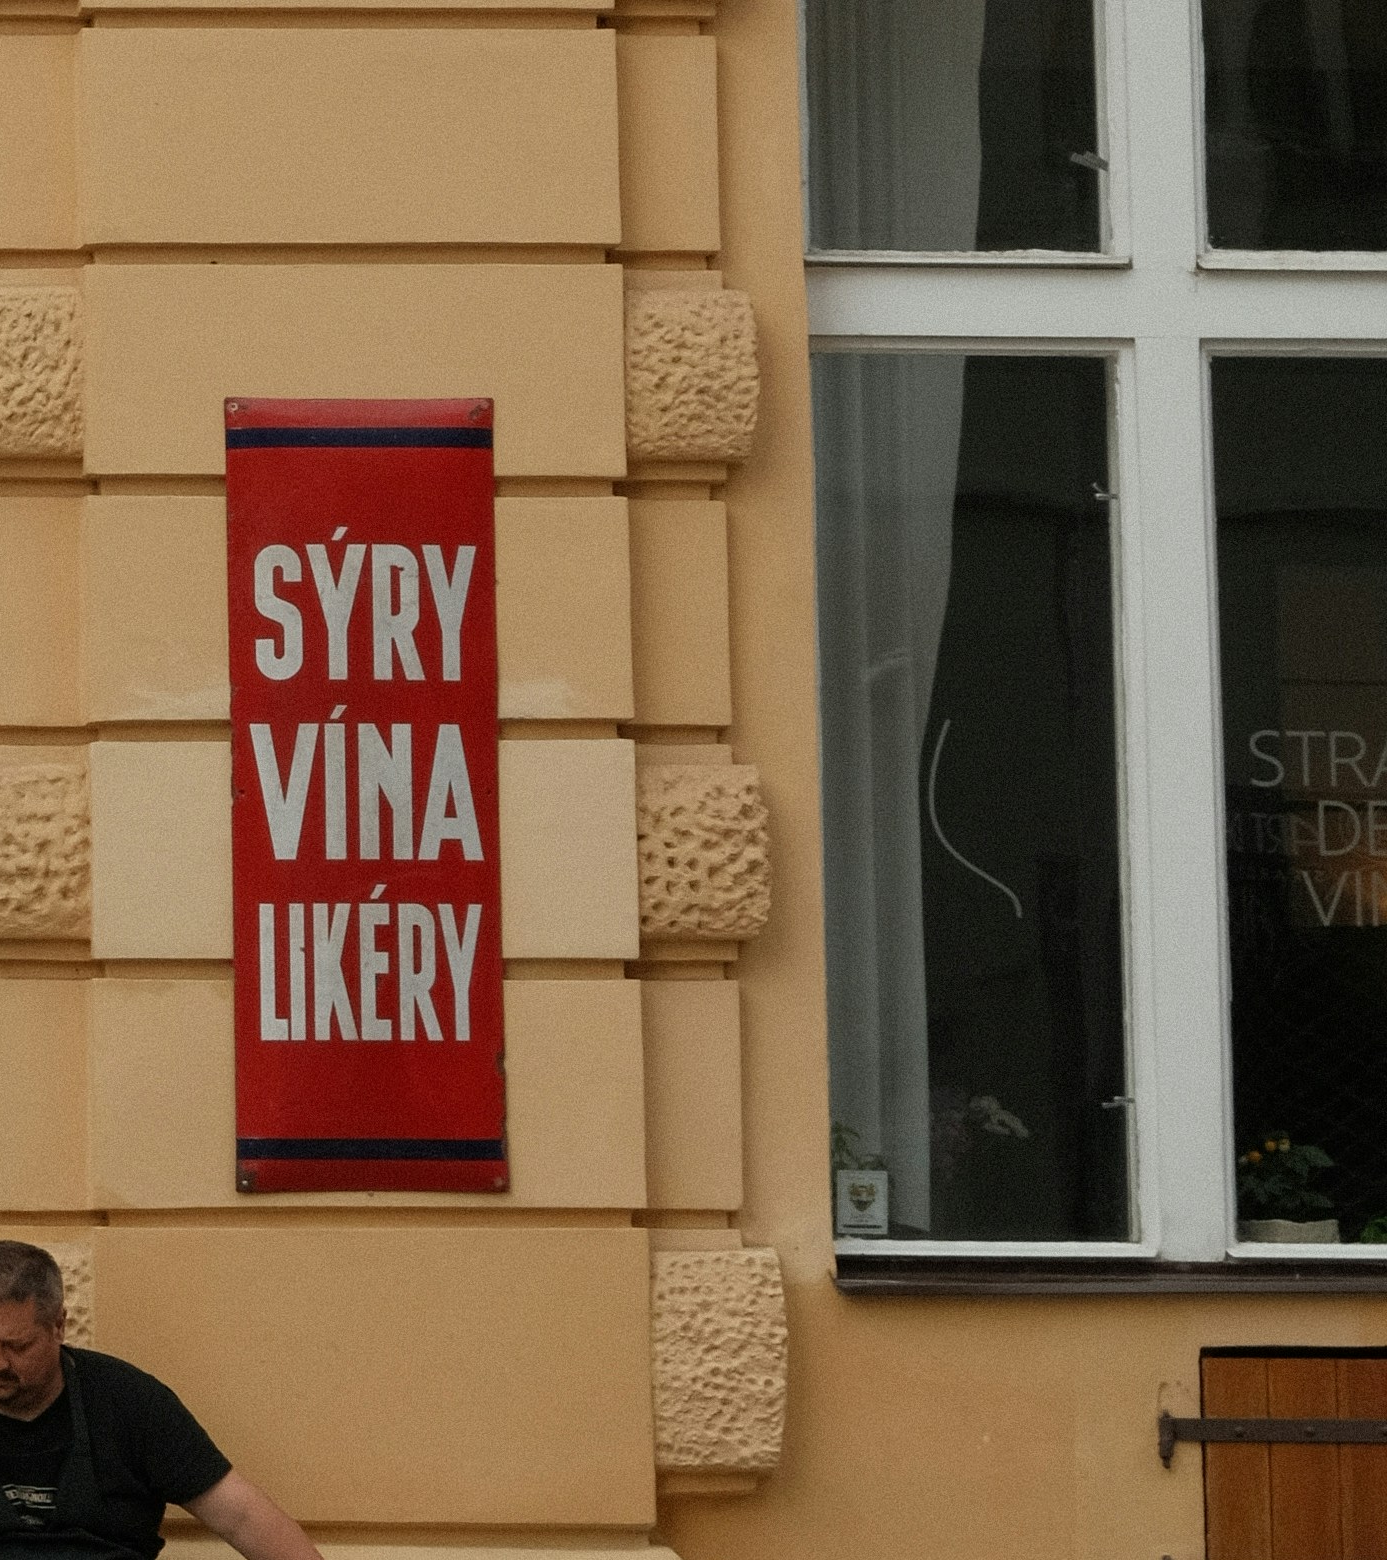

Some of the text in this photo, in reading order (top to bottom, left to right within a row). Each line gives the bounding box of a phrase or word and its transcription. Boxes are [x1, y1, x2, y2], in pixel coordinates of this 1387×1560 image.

[253, 526, 477, 682] SÝRY
[249, 704, 485, 861] VÍNA
[258, 884, 483, 1042] LIKÉRY
